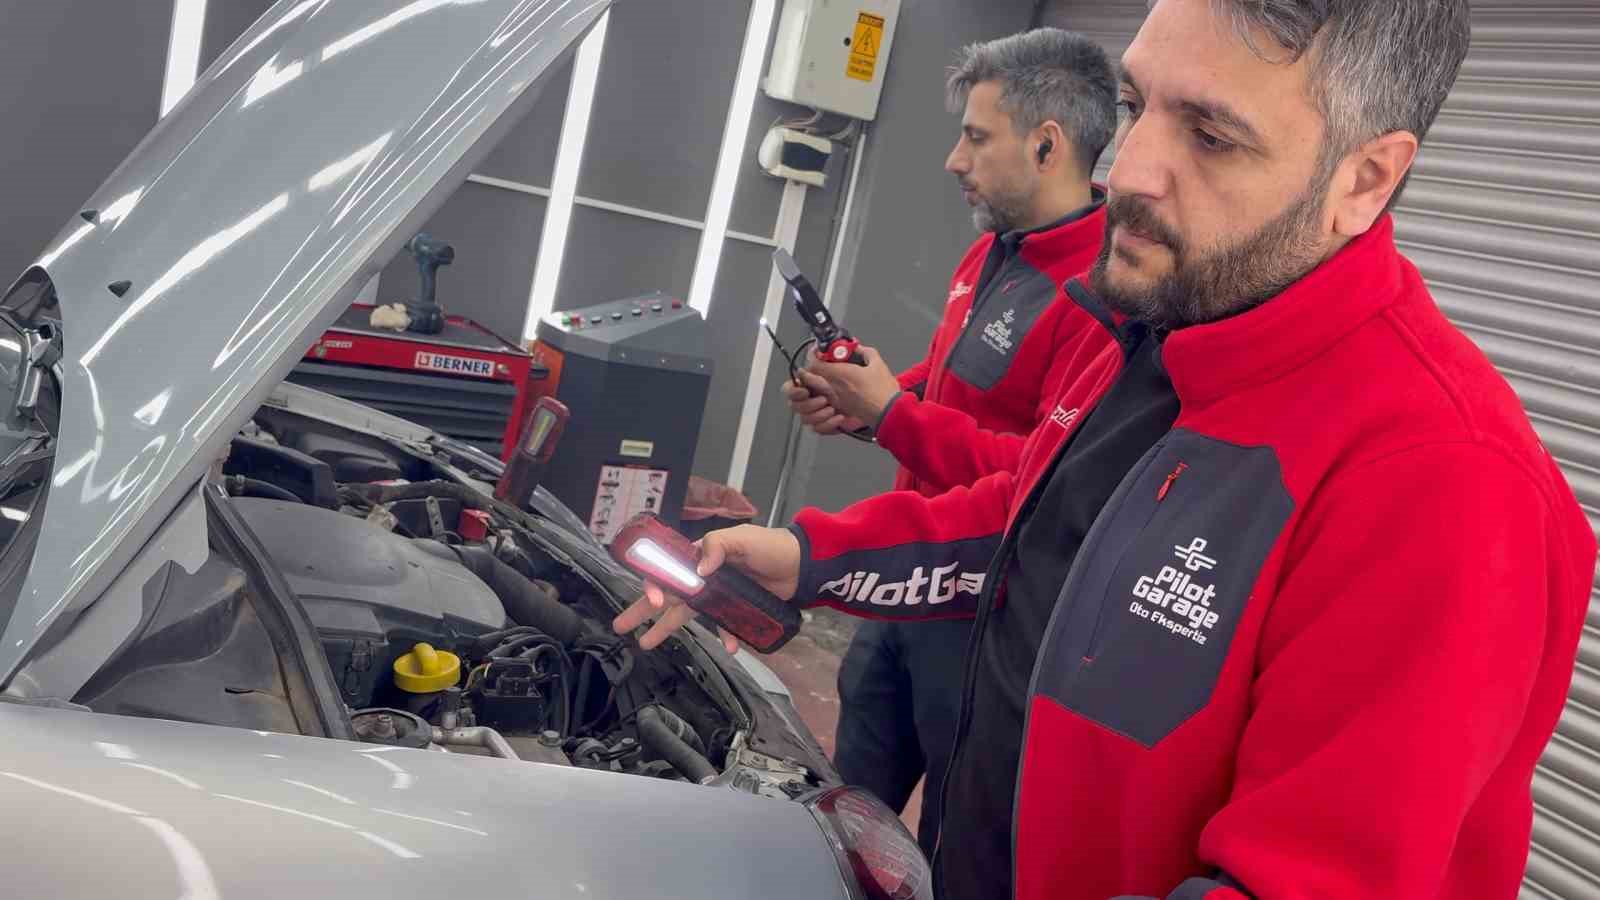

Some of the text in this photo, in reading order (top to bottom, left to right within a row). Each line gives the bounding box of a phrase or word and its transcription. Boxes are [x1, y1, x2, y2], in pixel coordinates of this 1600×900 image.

[433, 356, 490, 374] BERNER
[1132, 575, 1219, 629] Garage
[1154, 565, 1216, 607] Pilot
[1129, 601, 1207, 645] Oto Ekspertiz
